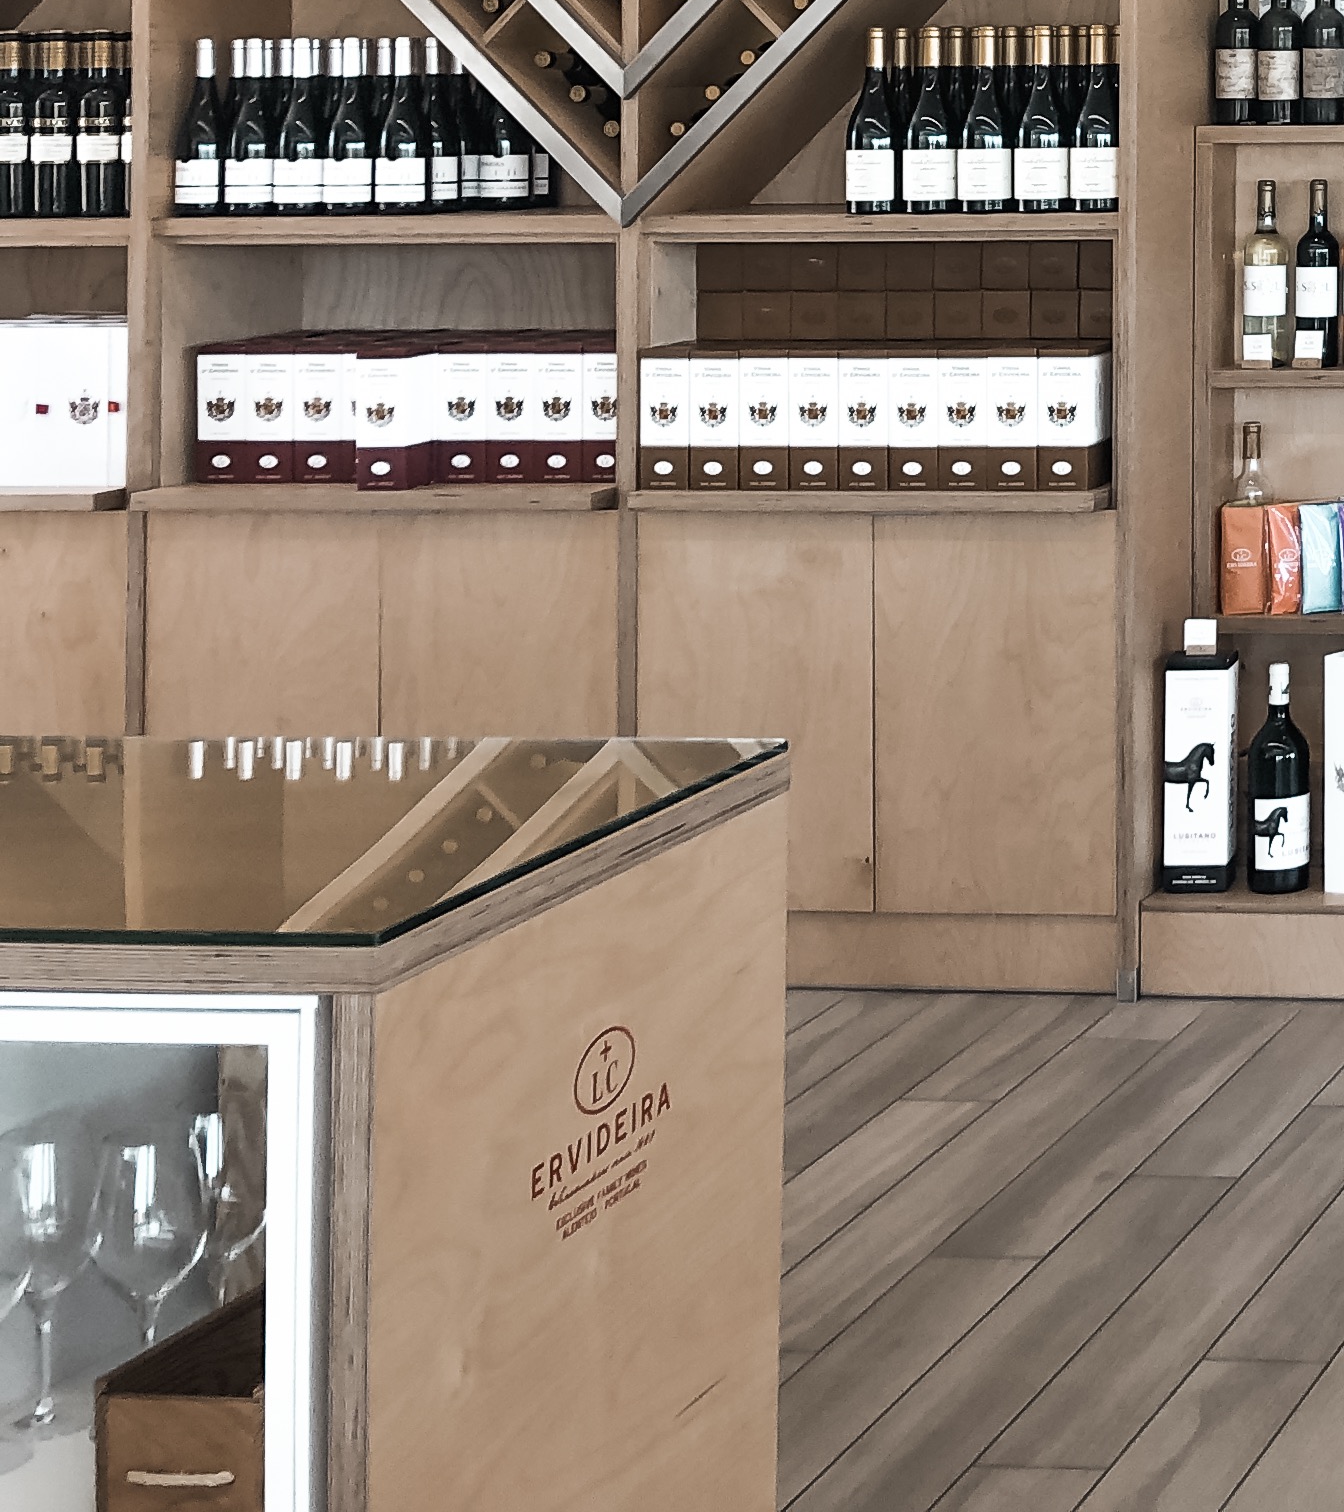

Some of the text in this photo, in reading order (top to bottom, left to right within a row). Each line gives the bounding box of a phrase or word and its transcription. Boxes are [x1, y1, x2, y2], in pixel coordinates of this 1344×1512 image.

[1173, 832, 1217, 840] LUSITANO
[591, 1059, 619, 1105] LC
[531, 1082, 671, 1202] ERVIDEIRA
[604, 1178, 641, 1210] PORTUGAL
